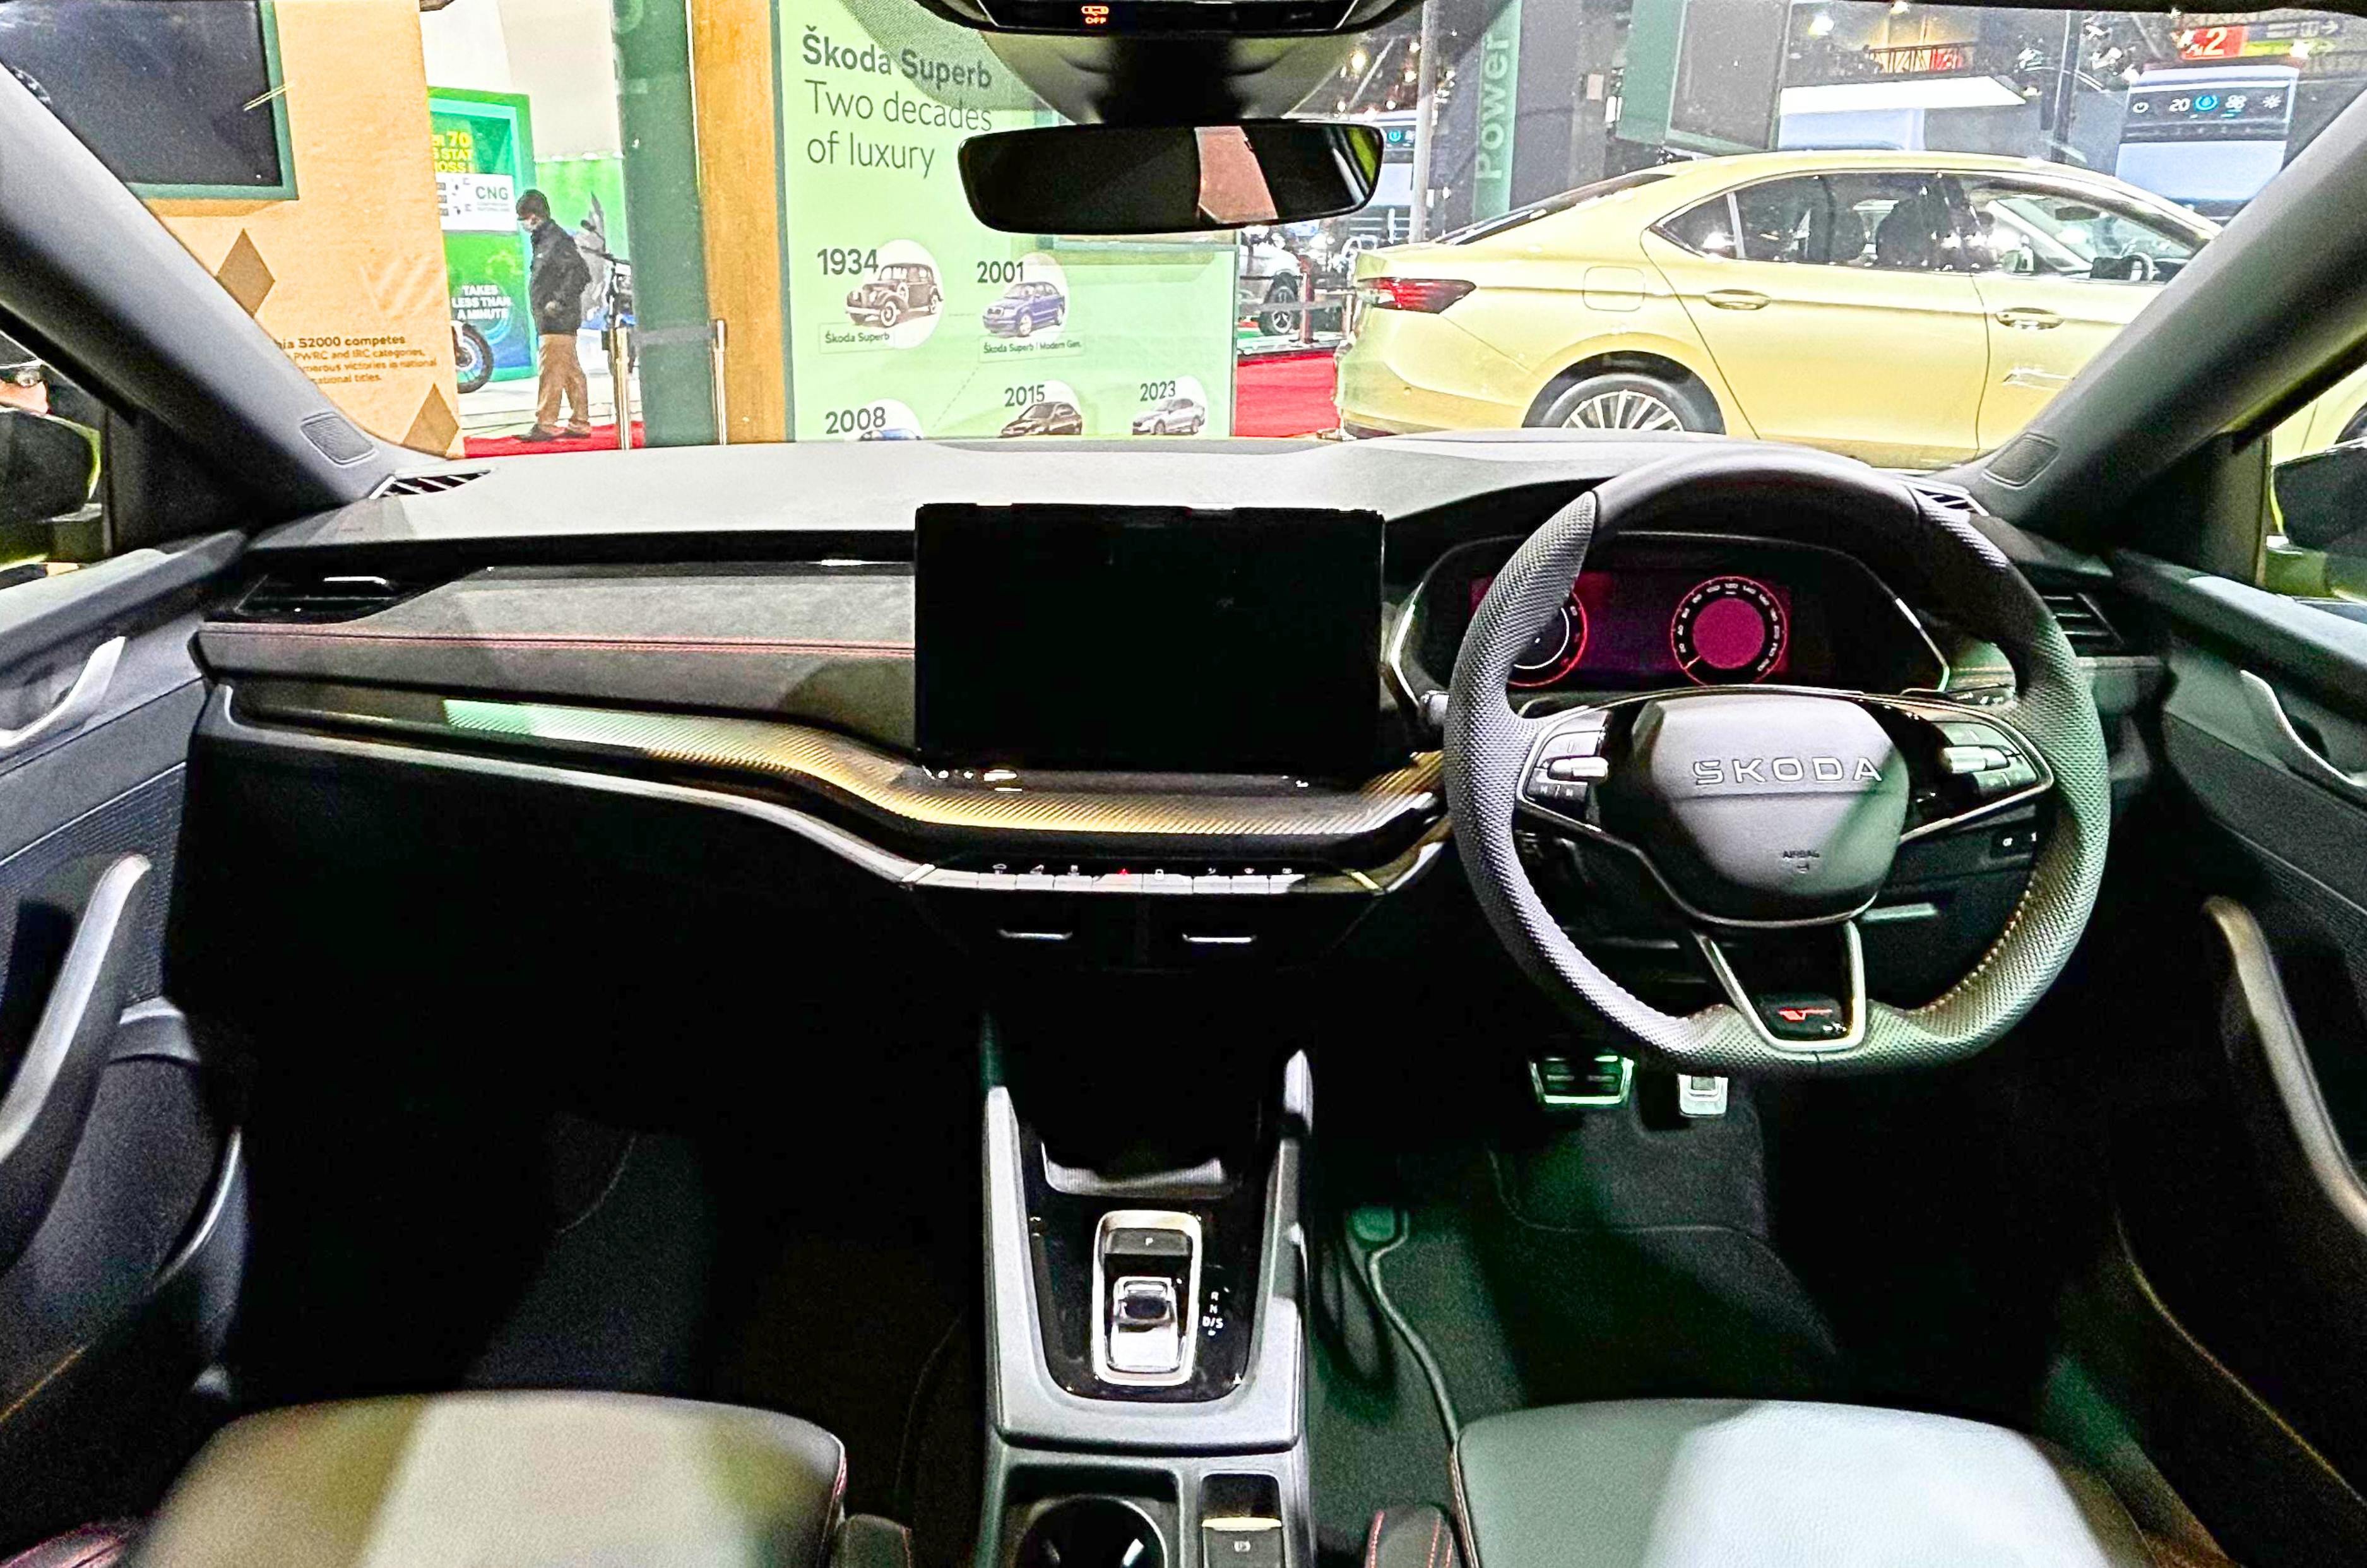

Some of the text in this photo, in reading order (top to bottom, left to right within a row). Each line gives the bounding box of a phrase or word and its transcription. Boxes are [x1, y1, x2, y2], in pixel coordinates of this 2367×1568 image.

[1085, 16, 1106, 25] OFF
[802, 24, 992, 91] Škoda Superb
[804, 79, 992, 131] Two decades
[1475, 33, 1509, 179] Power
[2169, 97, 2190, 112] 20
[446, 131, 472, 148] 70
[807, 130, 935, 179] of luxury
[475, 186, 509, 200] CNG
[817, 249, 879, 275] 1934
[976, 261, 1024, 284] 2001
[451, 297, 480, 309] LESS
[298, 336, 341, 348] S2000
[344, 335, 406, 347] competes
[825, 332, 890, 343] Škoda Superb
[331, 350, 350, 359] and
[1009, 343, 1034, 354] Superb
[1004, 384, 1045, 407] 2015
[1139, 381, 1176, 402] 2023
[825, 407, 887, 435] 2008
[1145, 1237, 1154, 1246] P
[1211, 1291, 1219, 1301] R
[1209, 1304, 1218, 1314] N
[1202, 1316, 1224, 1329] D/S
